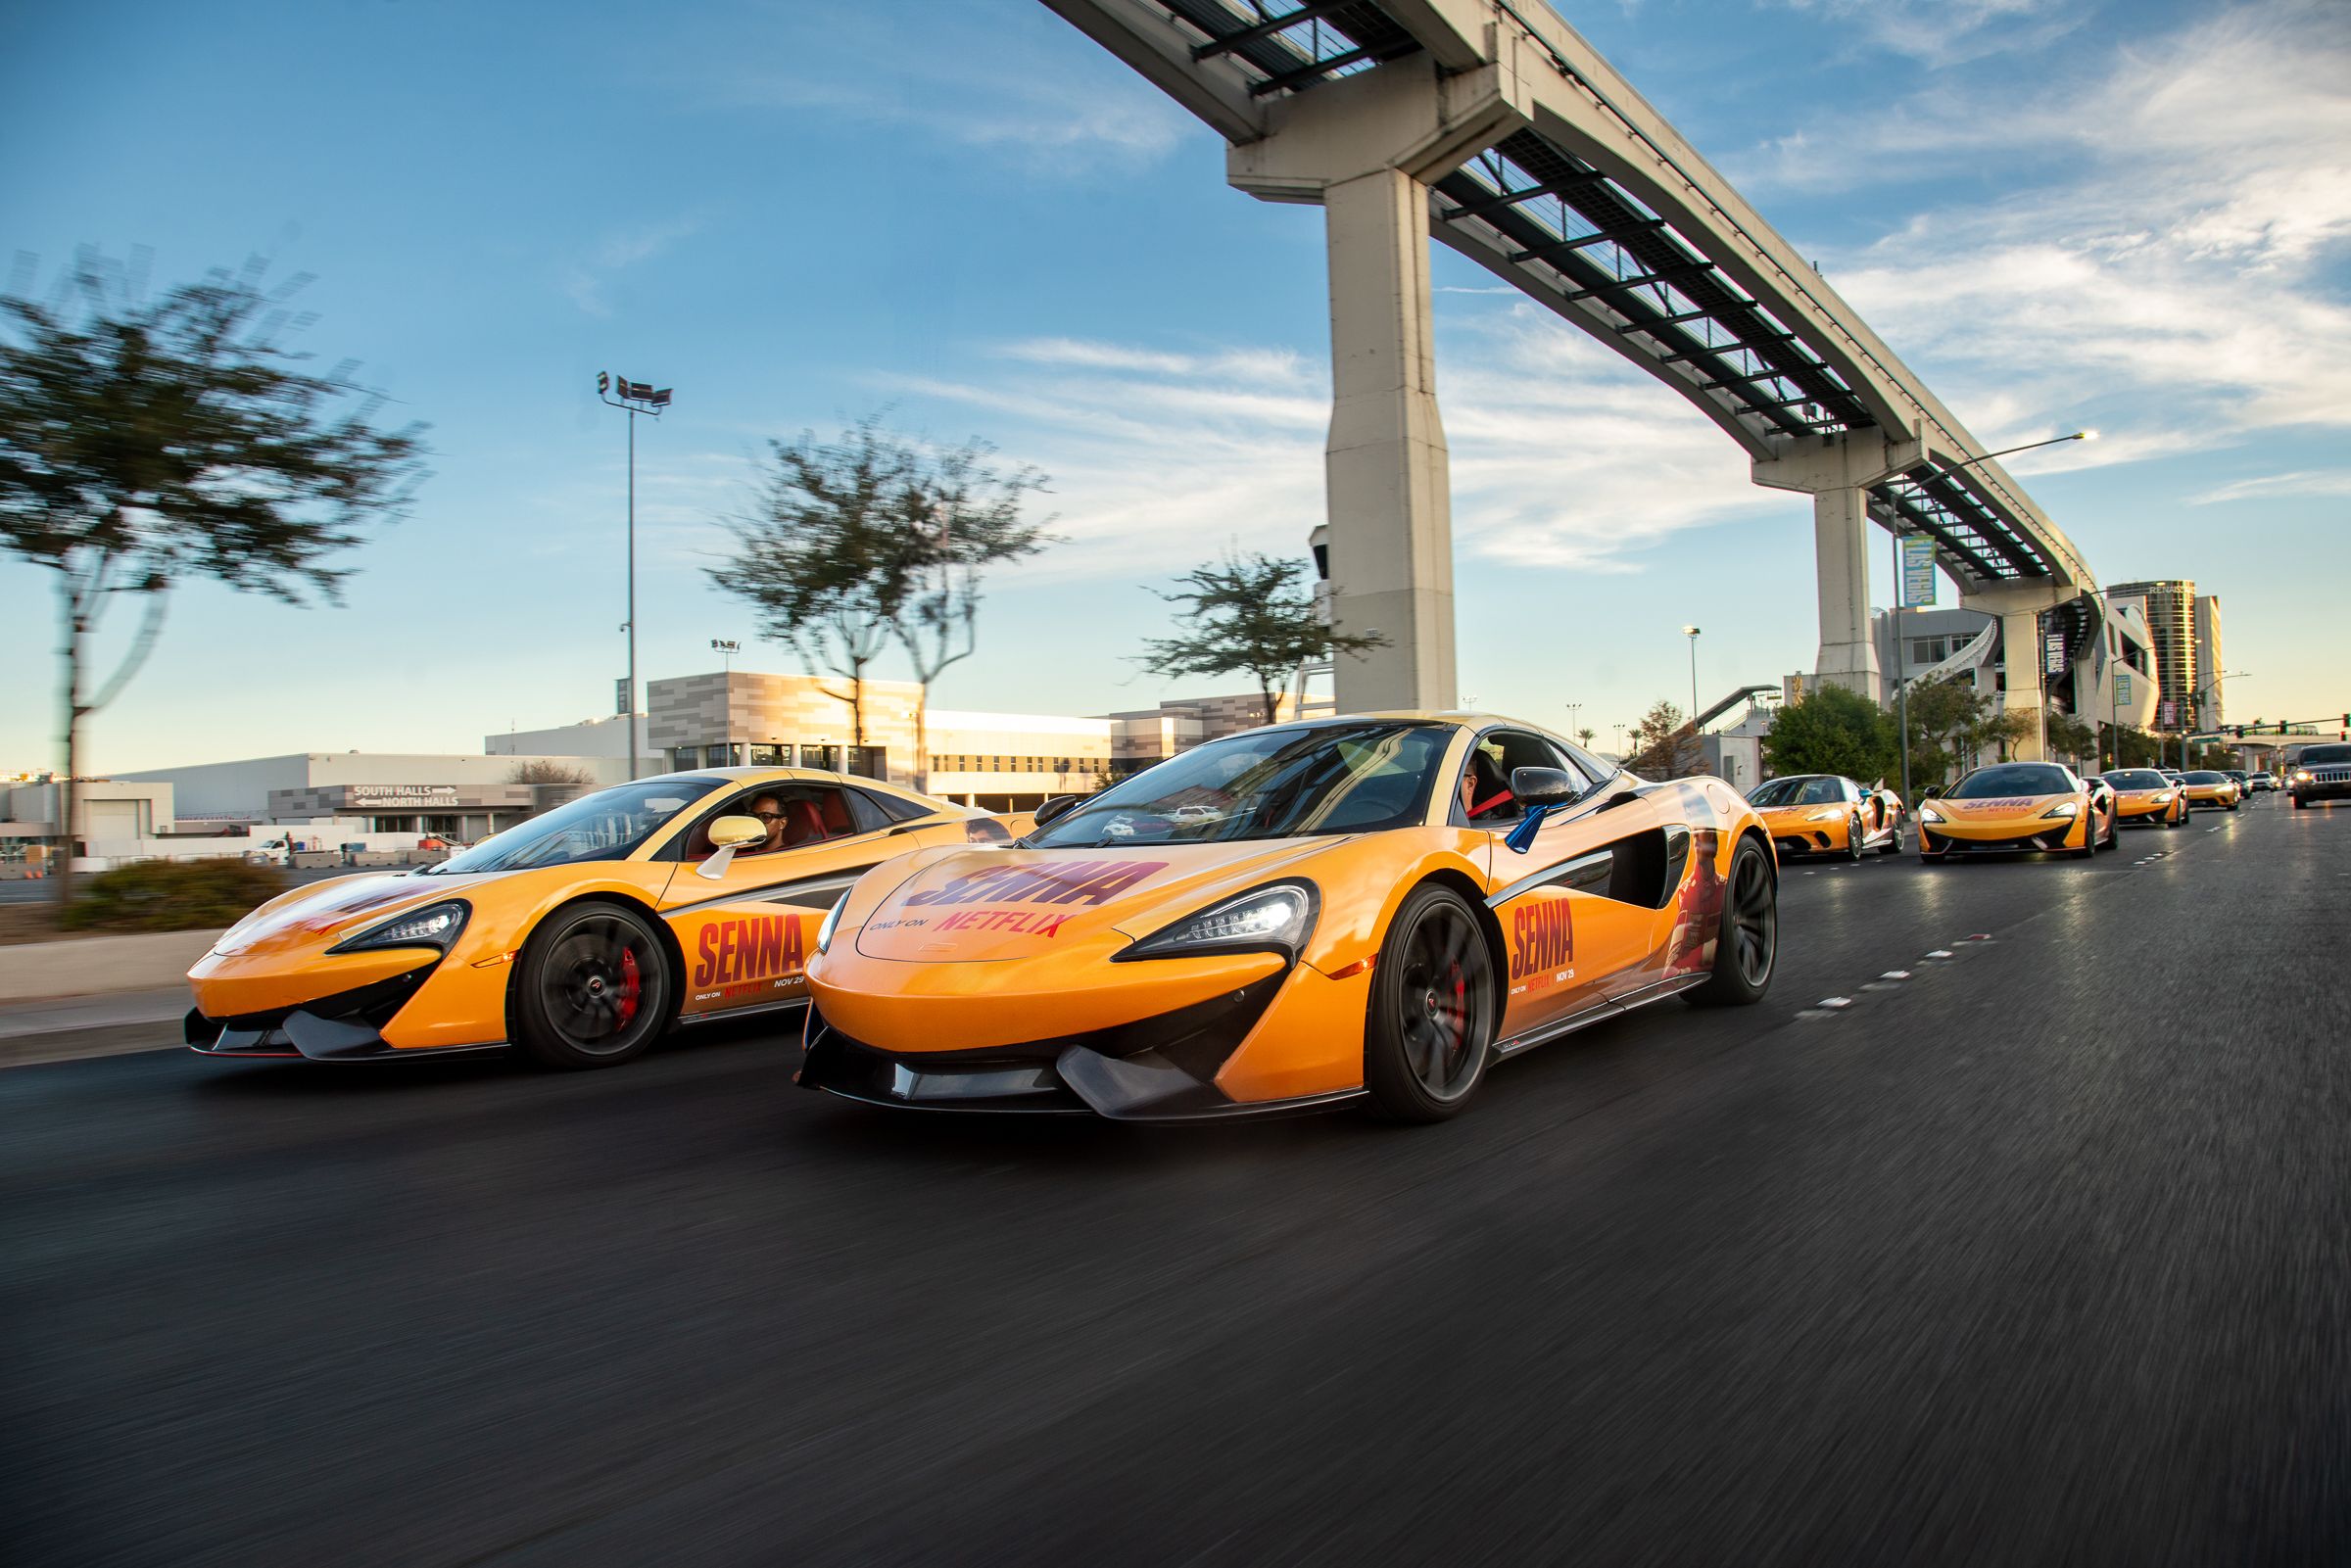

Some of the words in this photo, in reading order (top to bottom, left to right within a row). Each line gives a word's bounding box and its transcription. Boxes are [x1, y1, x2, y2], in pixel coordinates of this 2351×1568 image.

[1906, 546, 1933, 567] LAS
[1906, 570, 1934, 603] VEGAS
[2047, 639, 2063, 651] LAS
[2047, 651, 2064, 673] VEGAS
[354, 785, 393, 796] SOUTH
[397, 785, 431, 796] HALLS
[382, 797, 422, 807] NORTH
[424, 796, 458, 807] HALLS
[1963, 797, 2034, 809] SENNA
[901, 861, 1170, 906] SENNA
[870, 920, 903, 930] ONLY
[932, 911, 1078, 938] NETFLIX
[695, 914, 803, 988] SENNA
[1511, 897, 1573, 980] SENNA
[695, 992, 711, 1001] ONLY
[725, 981, 762, 999] NETFLIX
[774, 977, 793, 988] NOV
[793, 975, 805, 985] 29
[1528, 974, 1550, 993] NETFLIX
[1556, 971, 1567, 983] NOV
[1567, 968, 1575, 979] 29
